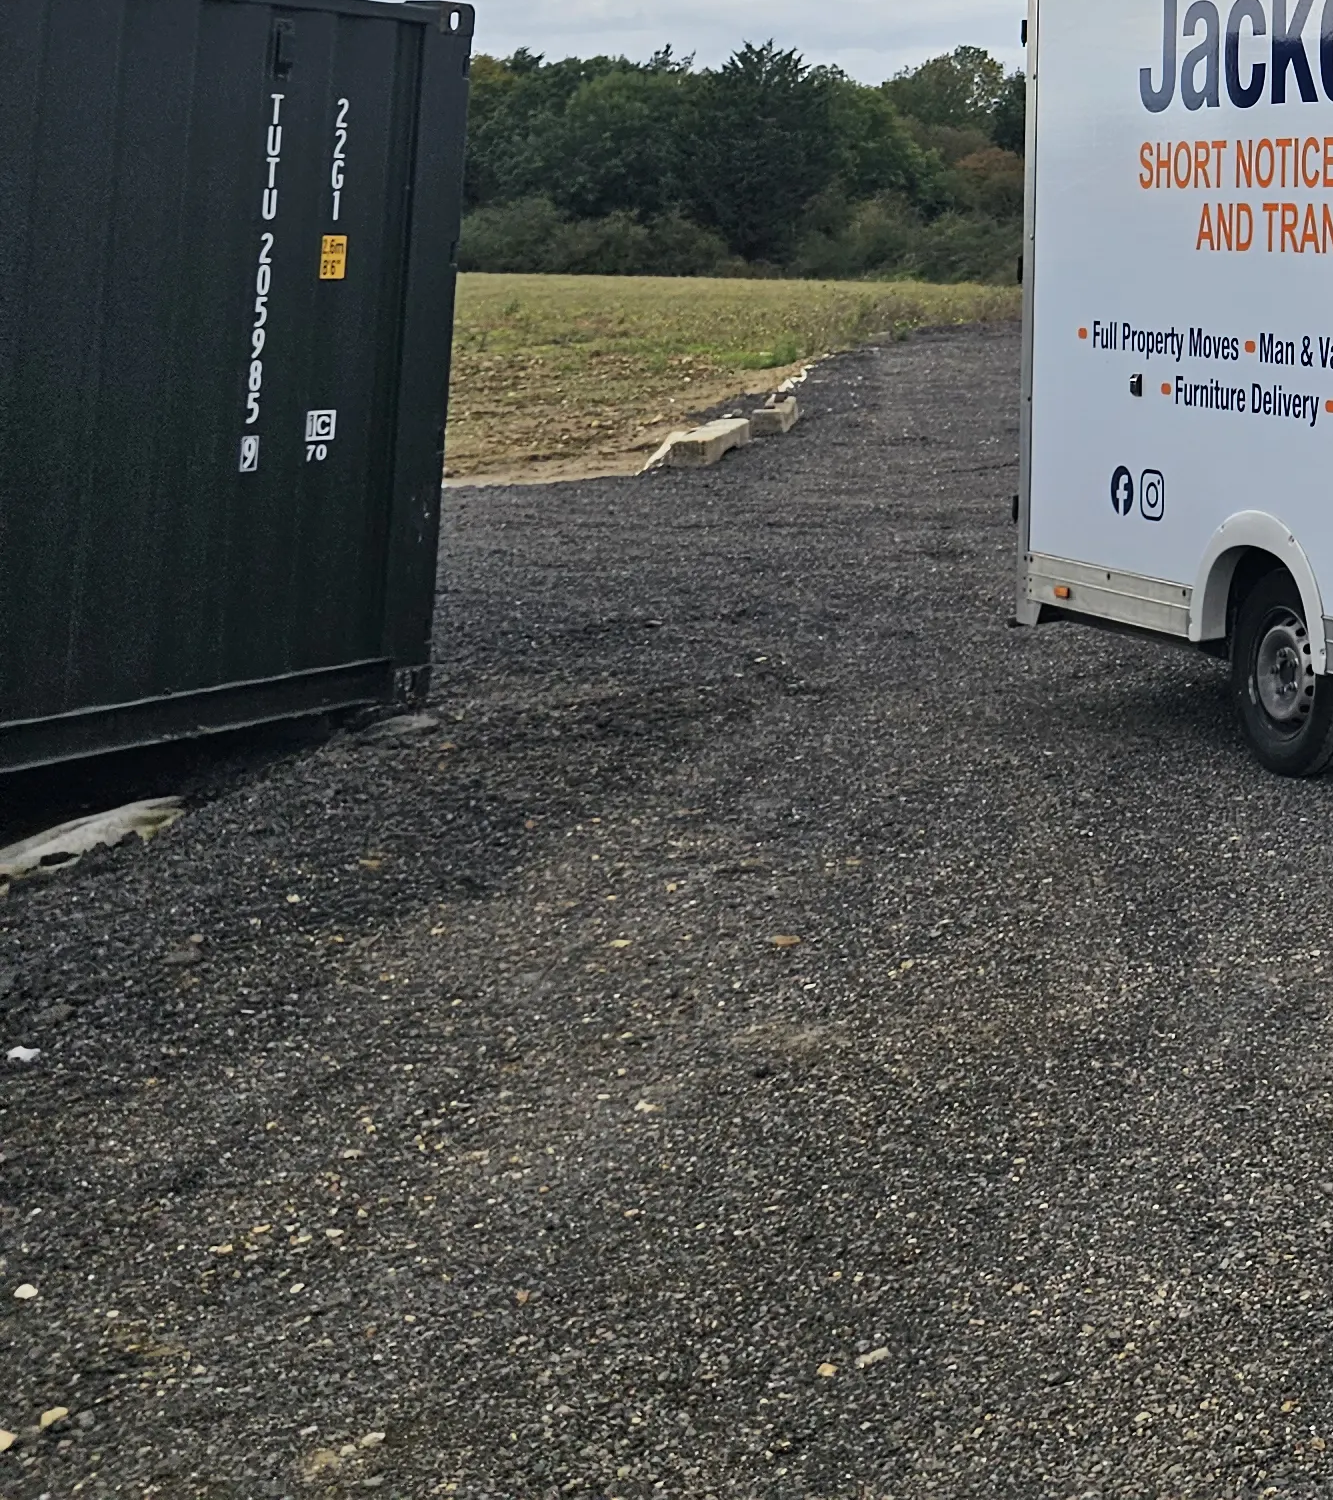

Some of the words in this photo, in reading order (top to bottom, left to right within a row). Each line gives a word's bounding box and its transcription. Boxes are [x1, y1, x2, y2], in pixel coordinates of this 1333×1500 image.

[261, 93, 285, 221] TUTU
[331, 98, 350, 221] 22G1
[1139, 140, 1227, 190] SHORT
[1196, 203, 1253, 252] AND
[244, 232, 274, 424] 205985
[1093, 320, 1118, 351] Full
[1122, 322, 1184, 362] Property
[1188, 327, 1240, 361] Moves
[1259, 332, 1295, 366] Man
[1300, 335, 1313, 368] &
[1175, 376, 1246, 413] Furniture
[1251, 383, 1320, 427] Delivery
[242, 436, 257, 470] 9
[306, 444, 328, 462] 70
